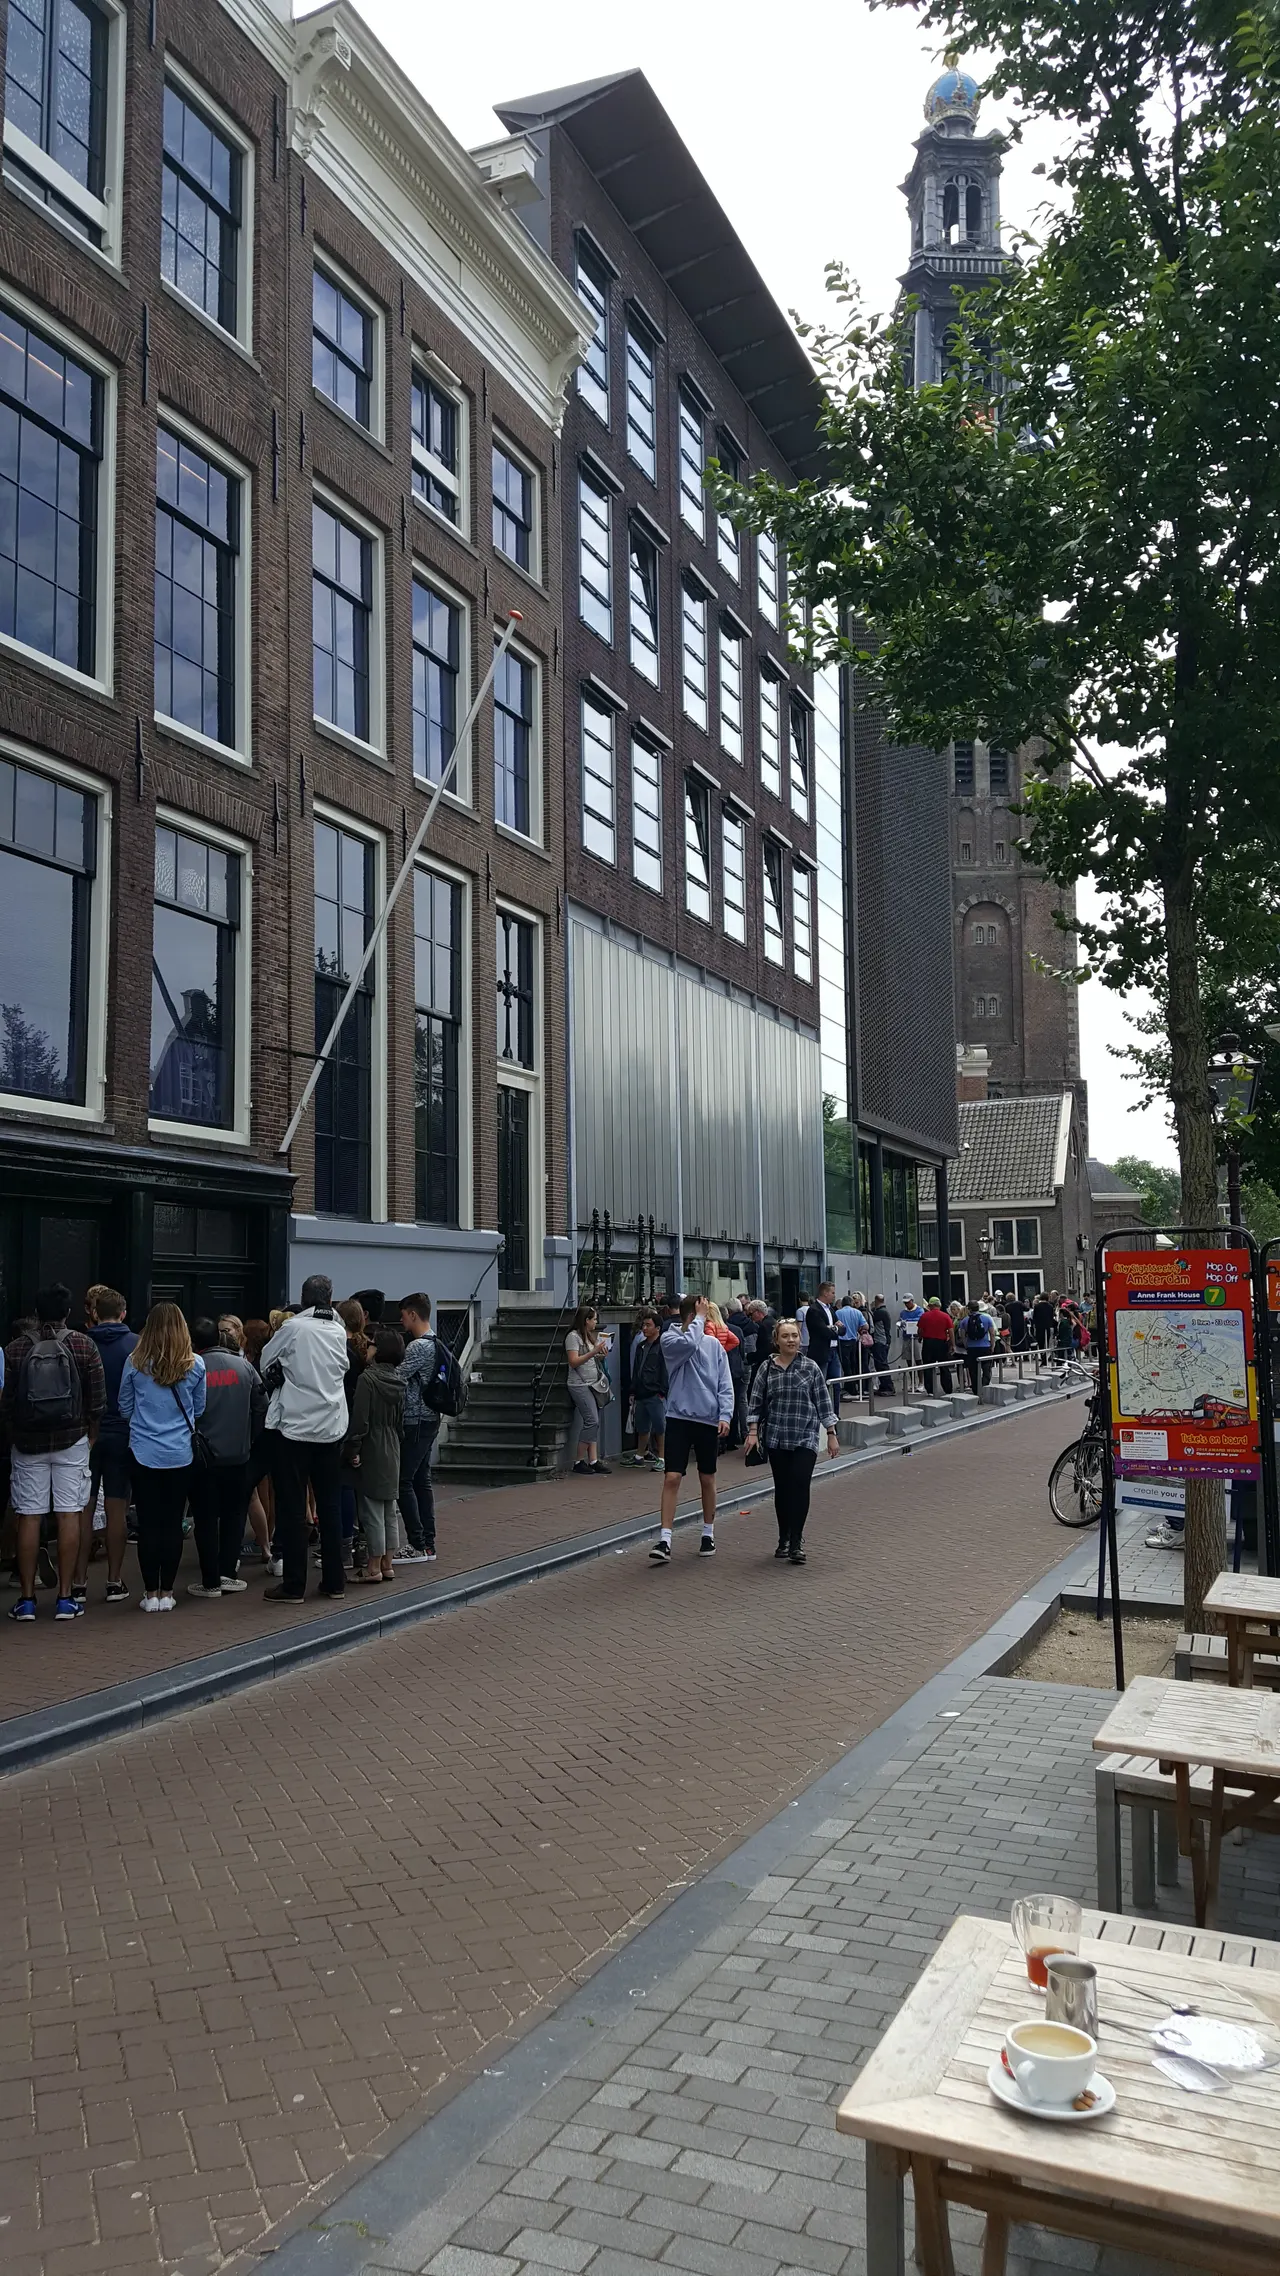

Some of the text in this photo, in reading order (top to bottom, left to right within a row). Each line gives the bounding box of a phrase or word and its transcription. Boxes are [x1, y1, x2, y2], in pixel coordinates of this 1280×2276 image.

[1113, 1263, 1181, 1274] City Sightseeing
[1206, 1262, 1238, 1272] Hop On
[1126, 1273, 1191, 1286] Amsterdam
[1205, 1273, 1239, 1283] Hop Off
[1208, 1288, 1220, 1303] 7
[1181, 1433, 1248, 1445] Tickets on board
[1133, 1487, 1159, 1496] create
[1160, 1490, 1178, 1498] your
